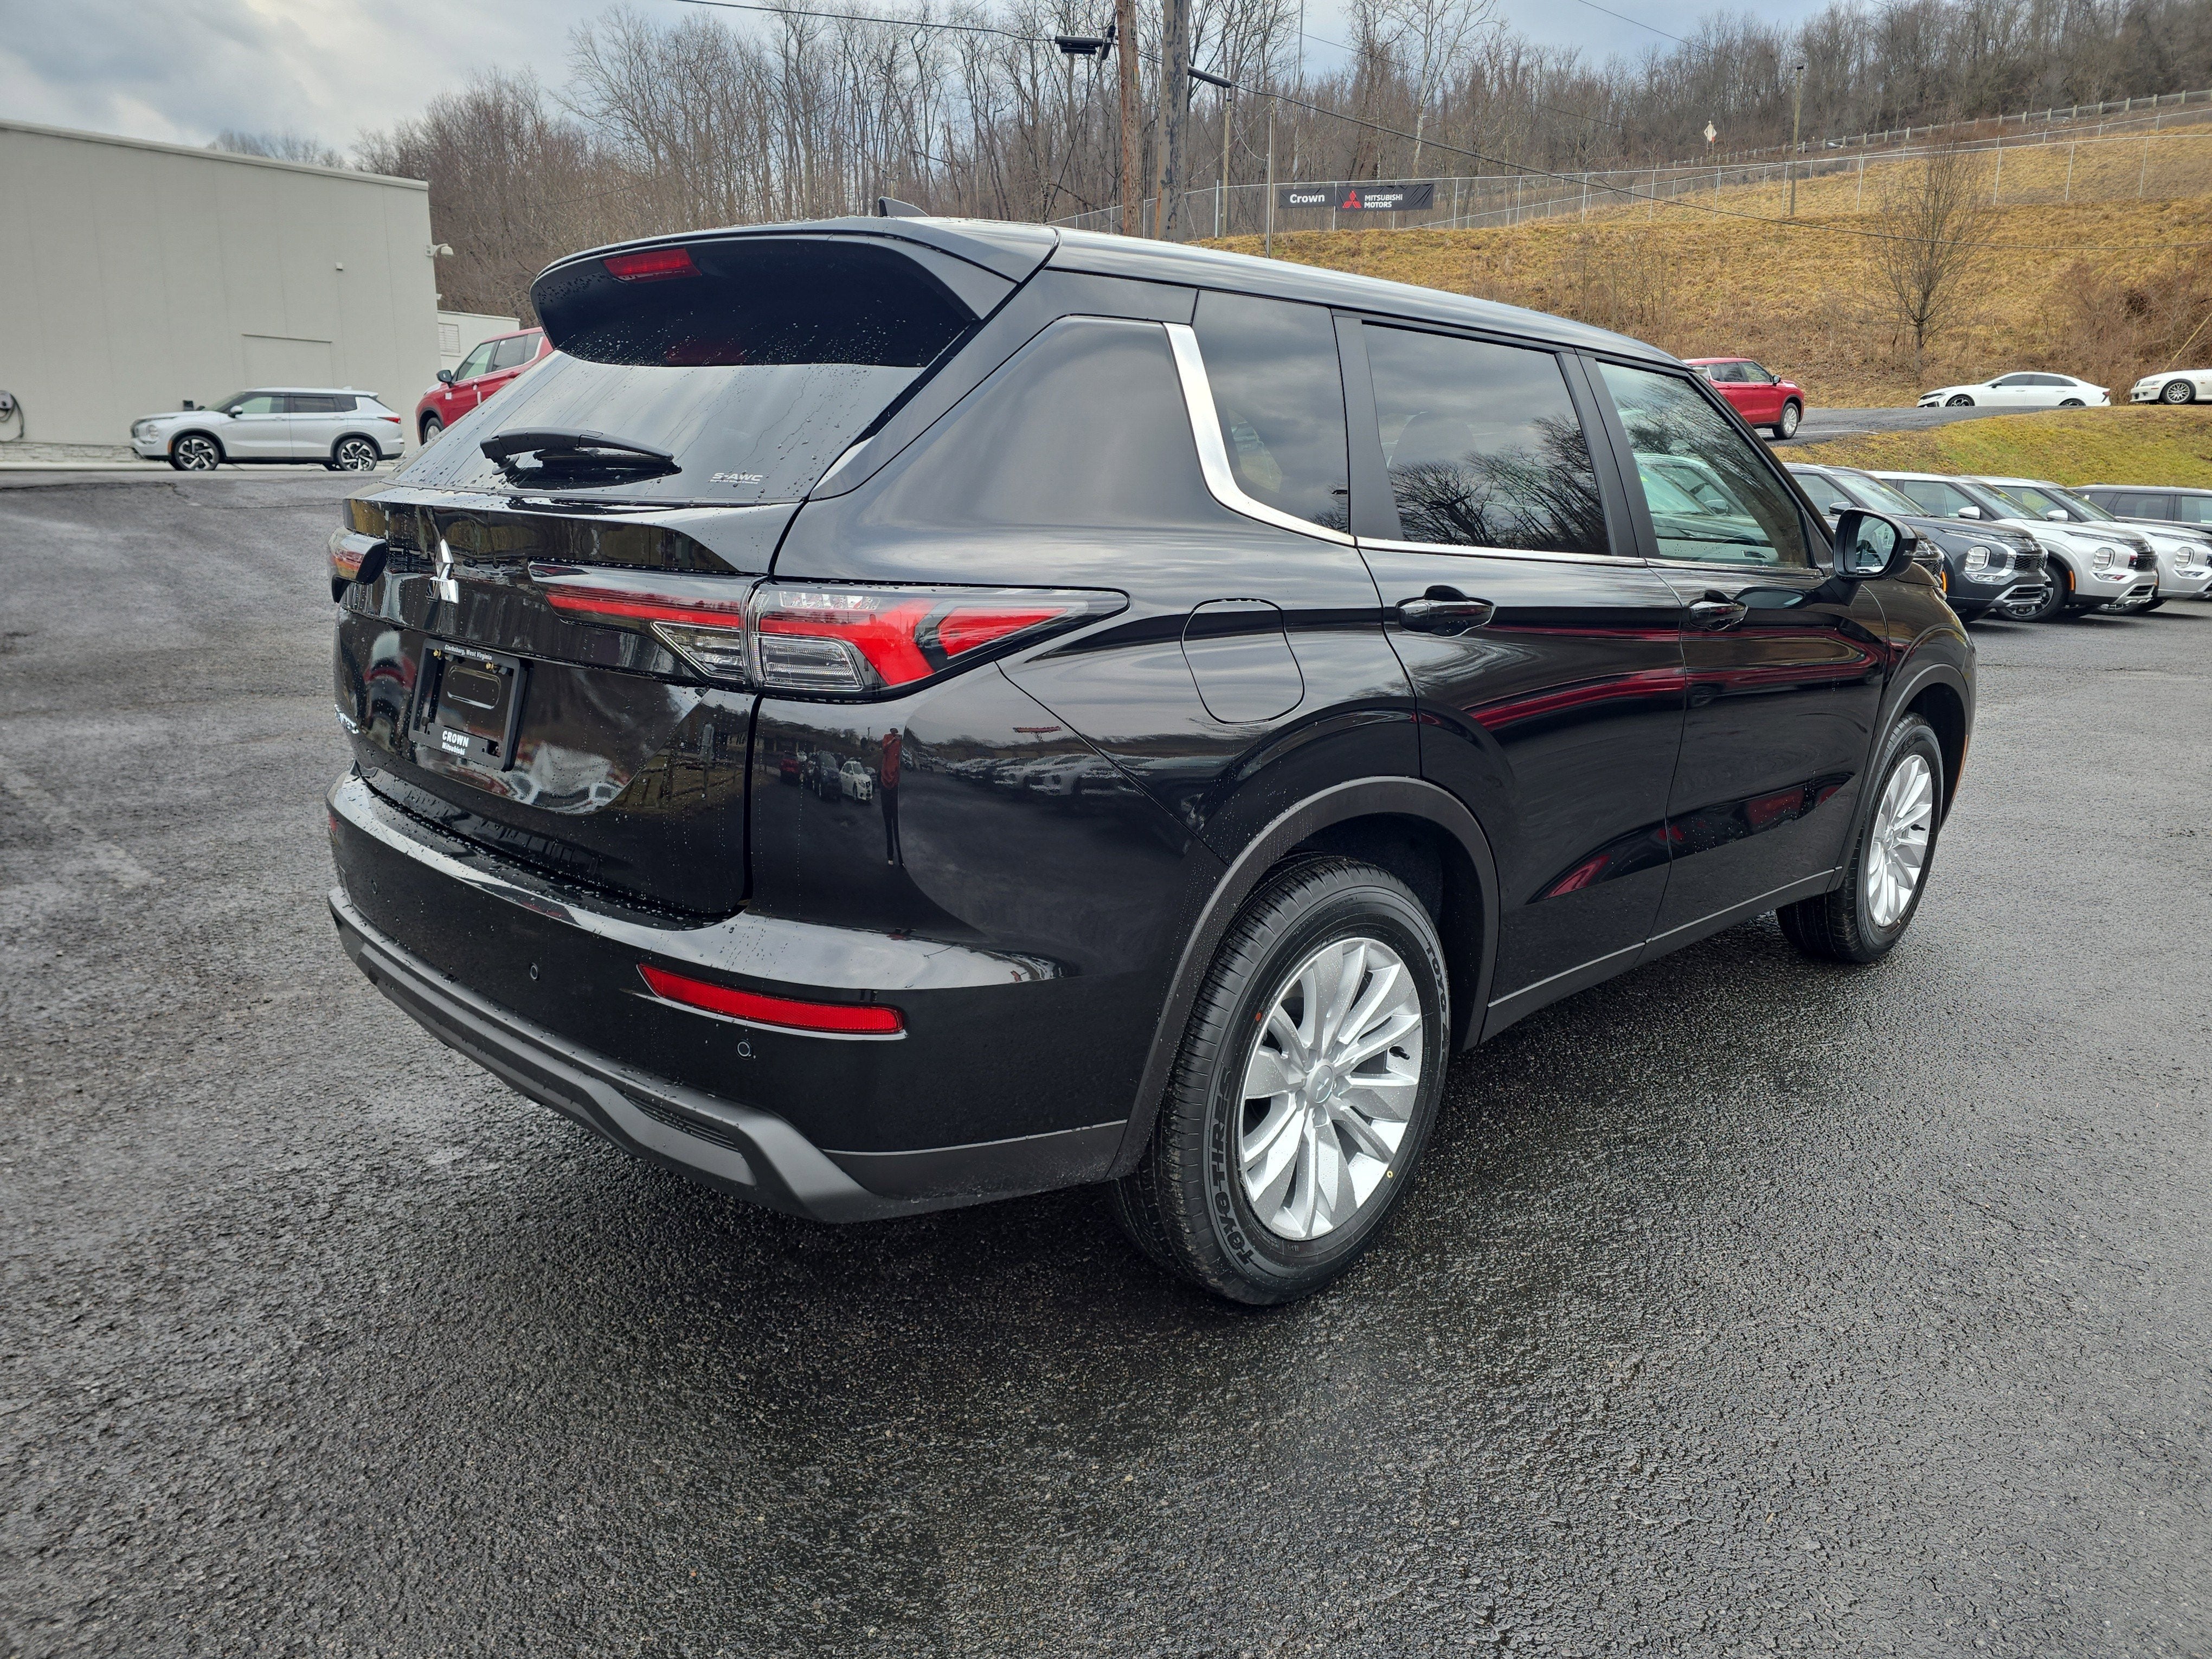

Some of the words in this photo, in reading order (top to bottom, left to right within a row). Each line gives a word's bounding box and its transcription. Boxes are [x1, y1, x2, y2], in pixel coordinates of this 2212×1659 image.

[1290, 194, 1325, 203] Crown
[712, 472, 763, 481] S-AWC
[466, 649, 476, 657] West
[477, 651, 492, 660] Virginia
[442, 730, 470, 747] CROWN
[442, 742, 466, 756] Mitsubishi
[1426, 941, 1447, 1012] TOYO
[1211, 1066, 1233, 1187] TIRES
[1214, 1191, 1255, 1266] TOYO
